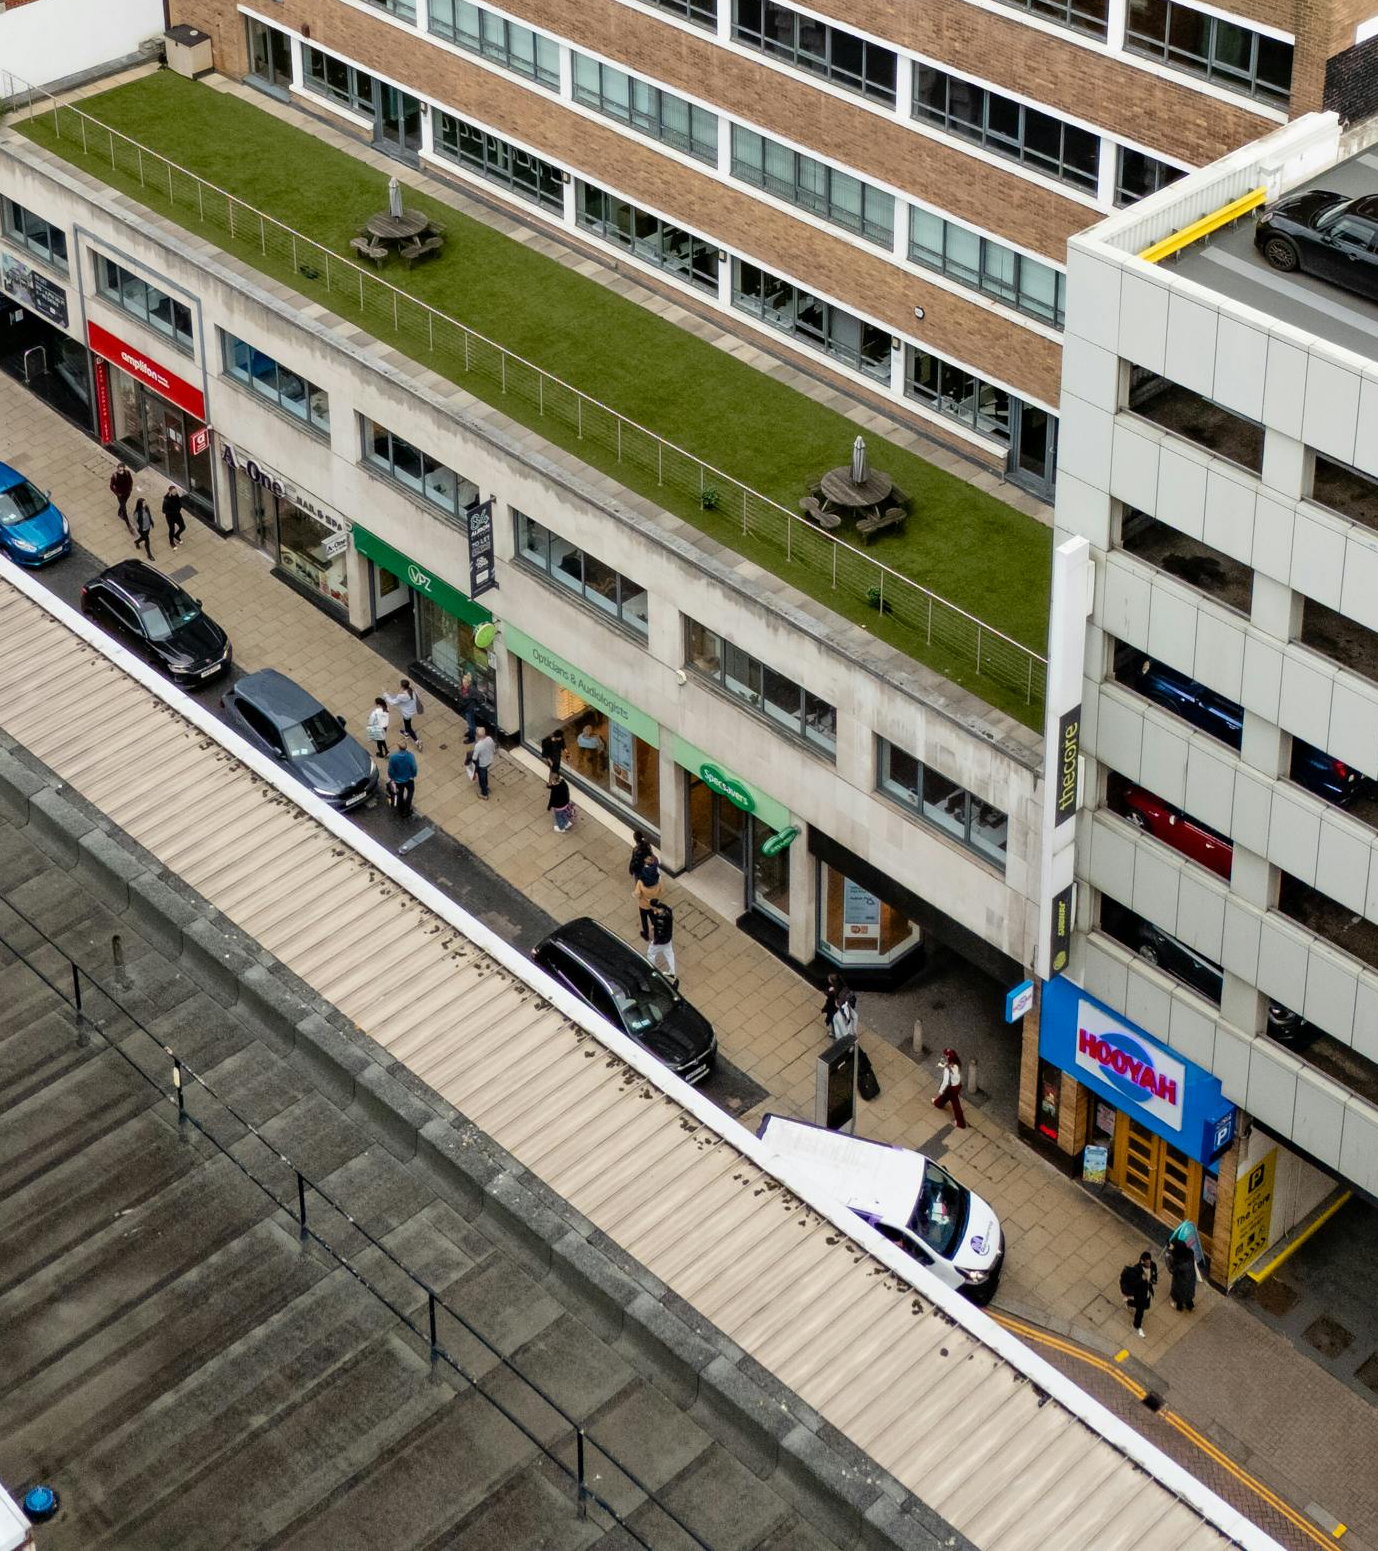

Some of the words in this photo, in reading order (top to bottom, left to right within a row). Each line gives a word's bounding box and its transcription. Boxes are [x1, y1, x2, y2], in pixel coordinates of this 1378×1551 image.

[121, 351, 158, 382] amplifon
[222, 443, 285, 499] A-One
[532, 648, 569, 684] Opticians
[570, 673, 577, 687] &
[577, 680, 629, 722] Audiologists
[703, 769, 748, 806] Specsavers
[1059, 721, 1079, 812] thecore
[1078, 1027, 1179, 1107] HOOYAH
[1216, 1127, 1228, 1146] P
